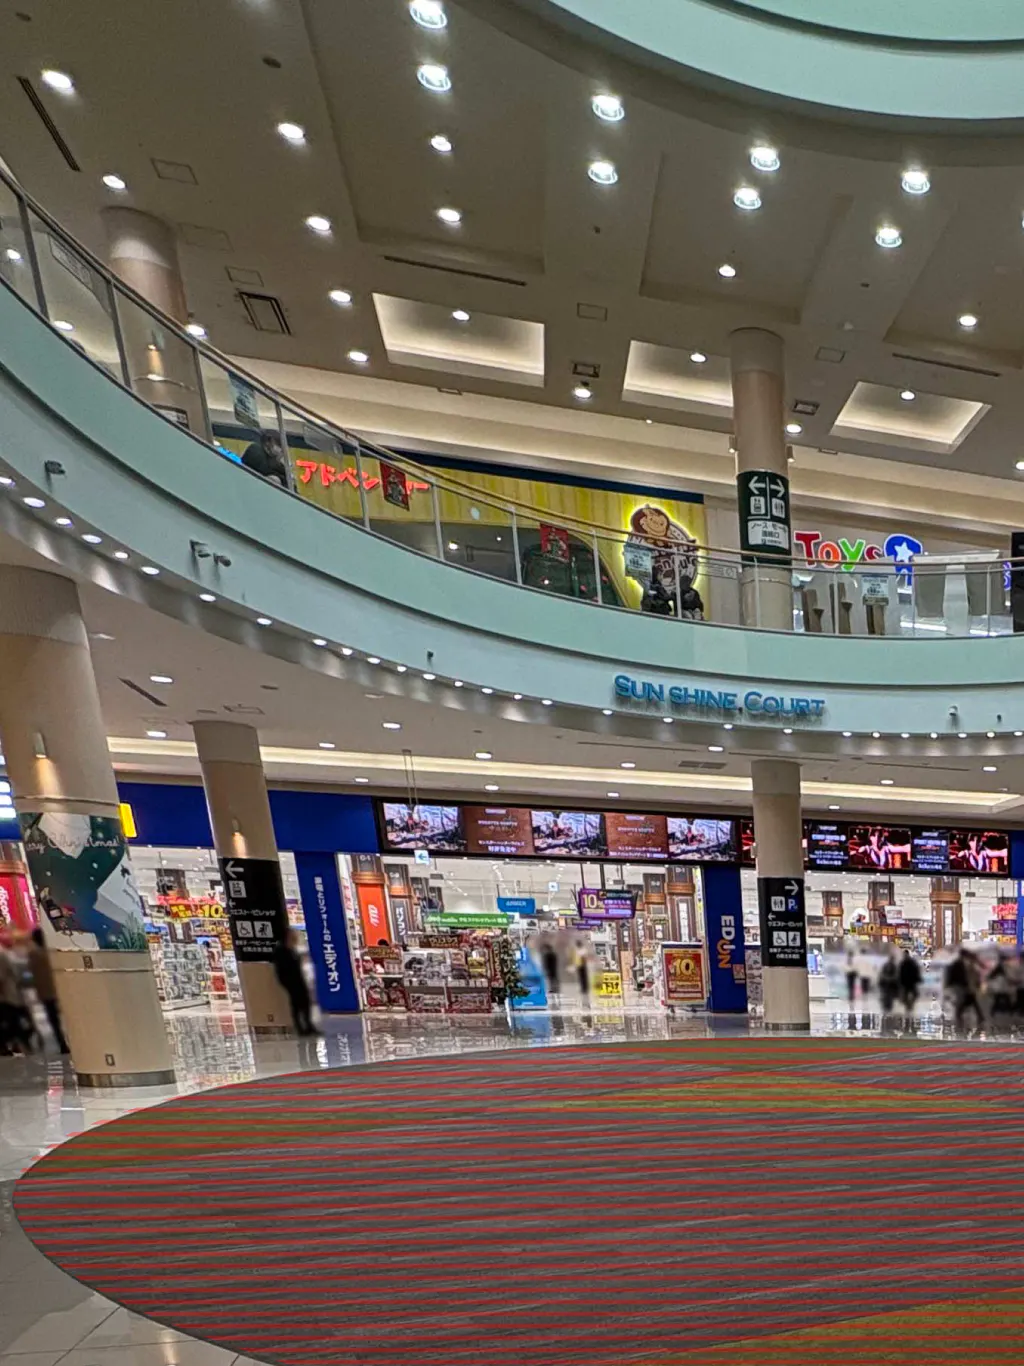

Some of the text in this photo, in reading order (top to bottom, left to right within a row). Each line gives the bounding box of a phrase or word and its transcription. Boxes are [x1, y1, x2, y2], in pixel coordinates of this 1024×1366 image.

[296, 460, 429, 497] アドベンャー
[614, 675, 825, 716] SUN SHINE COURT
[322, 944, 341, 992] エディオン
